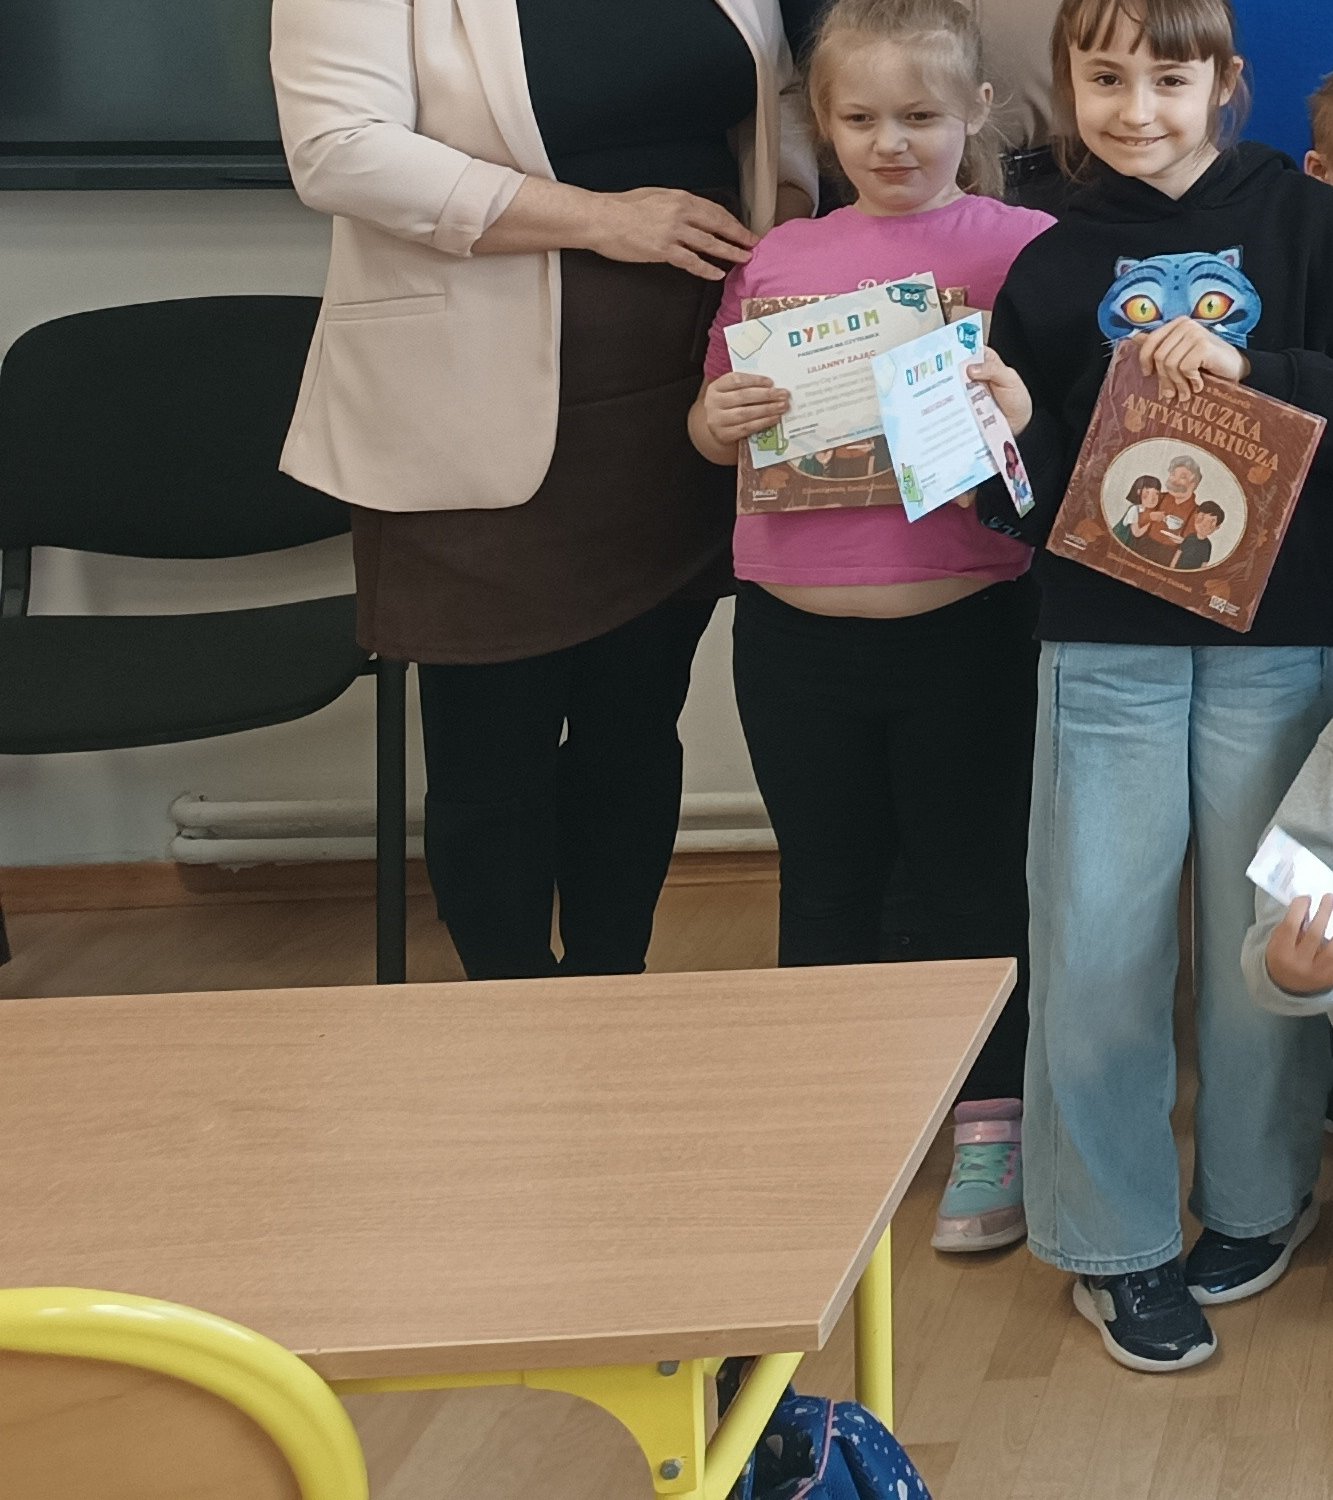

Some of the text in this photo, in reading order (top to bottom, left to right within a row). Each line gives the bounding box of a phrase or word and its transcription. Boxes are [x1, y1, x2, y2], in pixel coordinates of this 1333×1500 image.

[788, 309, 880, 348] DYPLOM
[905, 351, 954, 386] DYPLOM
[1121, 393, 1279, 471] ANTYKWARIUSZA
[1166, 396, 1262, 443] NUCZKA
